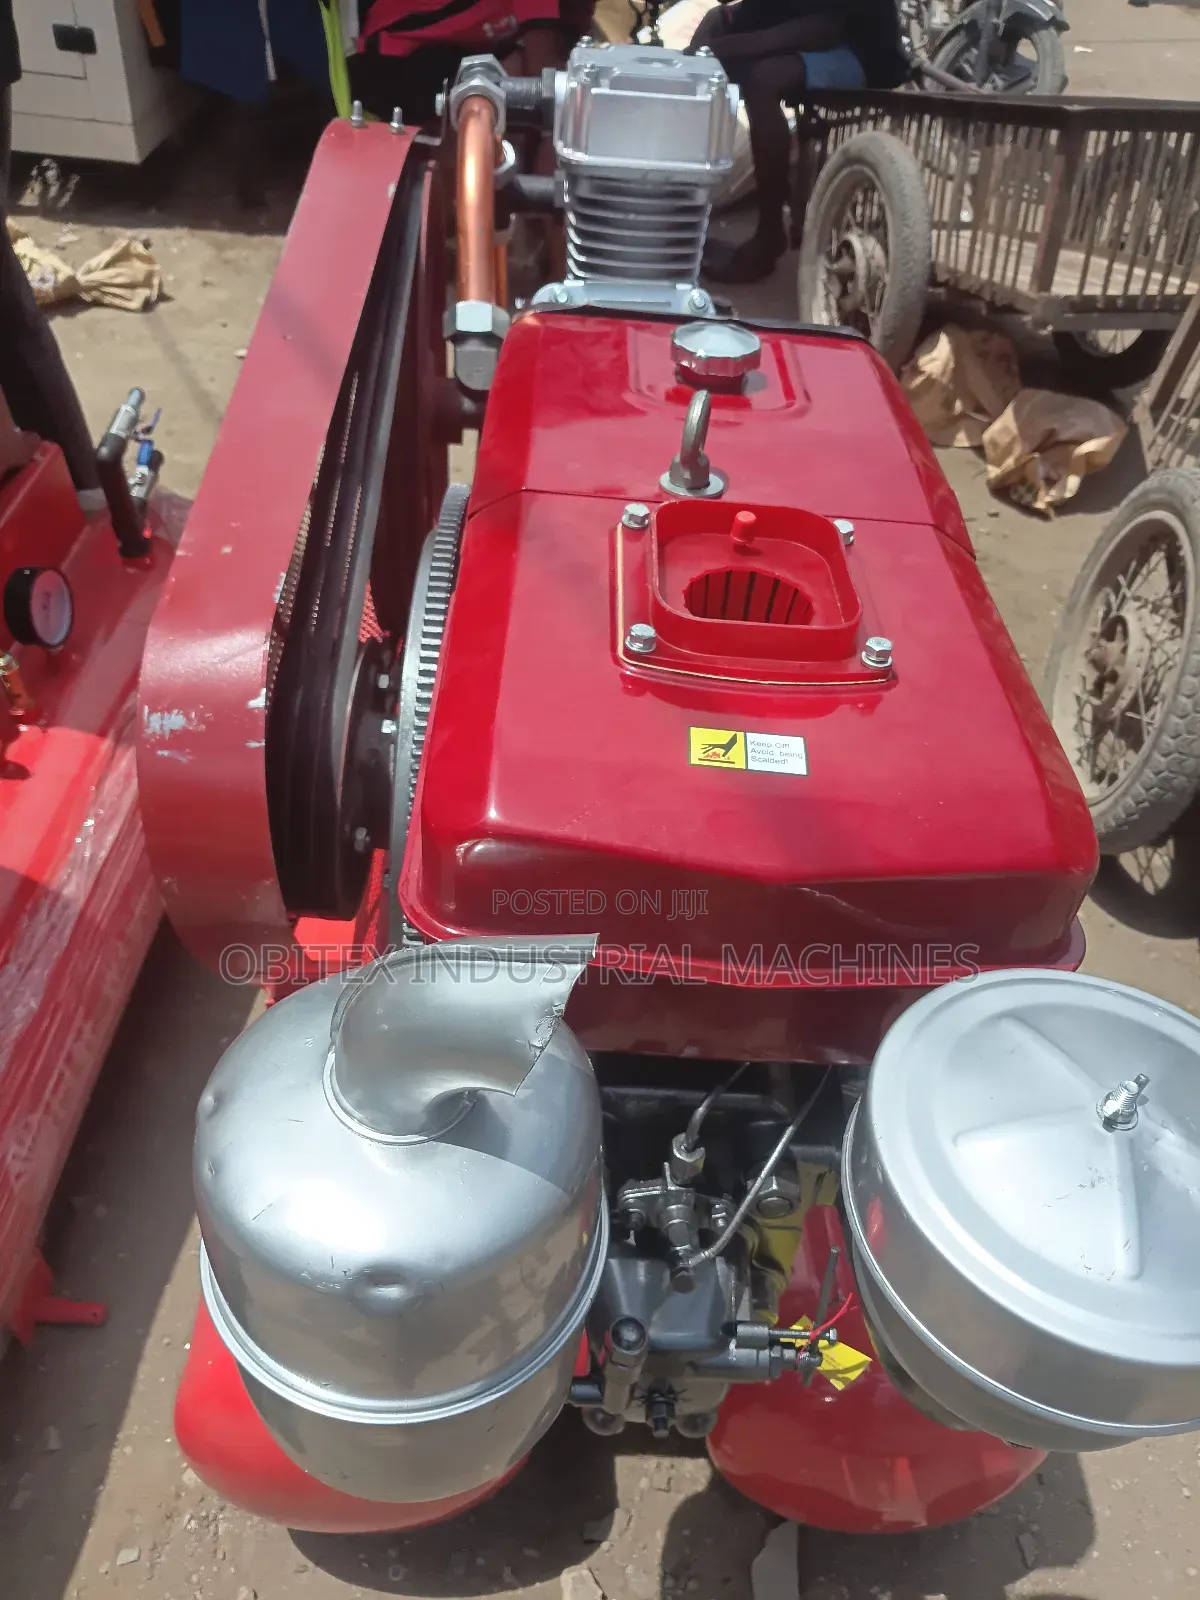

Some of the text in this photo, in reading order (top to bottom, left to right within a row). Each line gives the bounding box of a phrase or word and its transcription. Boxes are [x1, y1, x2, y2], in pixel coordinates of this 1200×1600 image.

[750, 740, 772, 748] Keep
[750, 747, 803, 760] Avoid being
